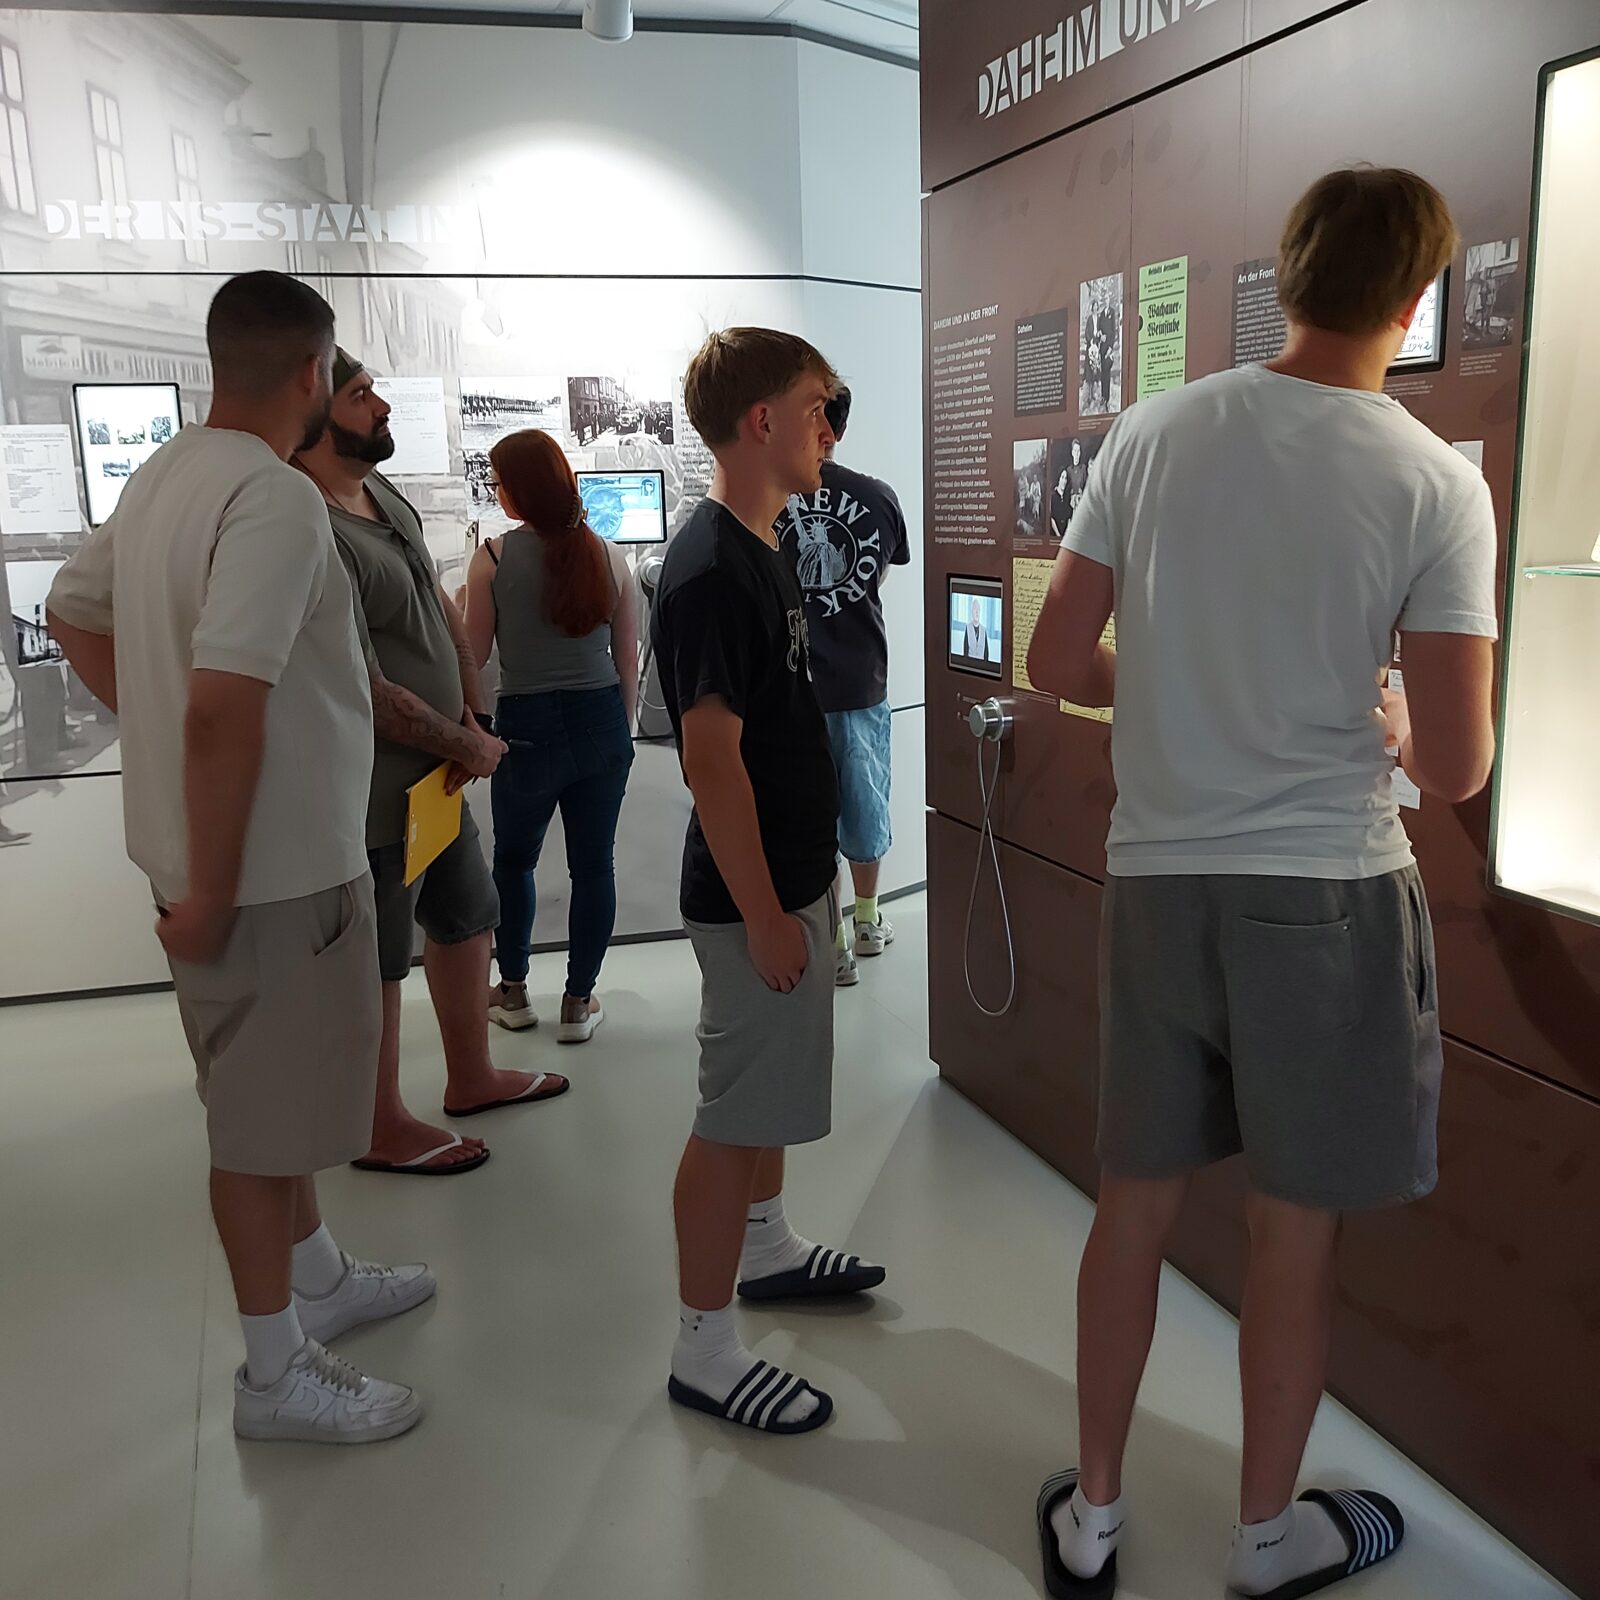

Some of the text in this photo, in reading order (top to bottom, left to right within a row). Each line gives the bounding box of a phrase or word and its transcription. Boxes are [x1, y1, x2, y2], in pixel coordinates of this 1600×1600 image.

[976, 0, 1201, 119] DAHEIM UN
[41, 200, 141, 240] DER
[1238, 267, 1276, 284] An der Front
[934, 316, 952, 331] DAHEIM
[952, 314, 963, 326] UND
[971, 309, 981, 321] DER
[982, 304, 999, 318] FRONT
[786, 488, 880, 617] NEW YORK
